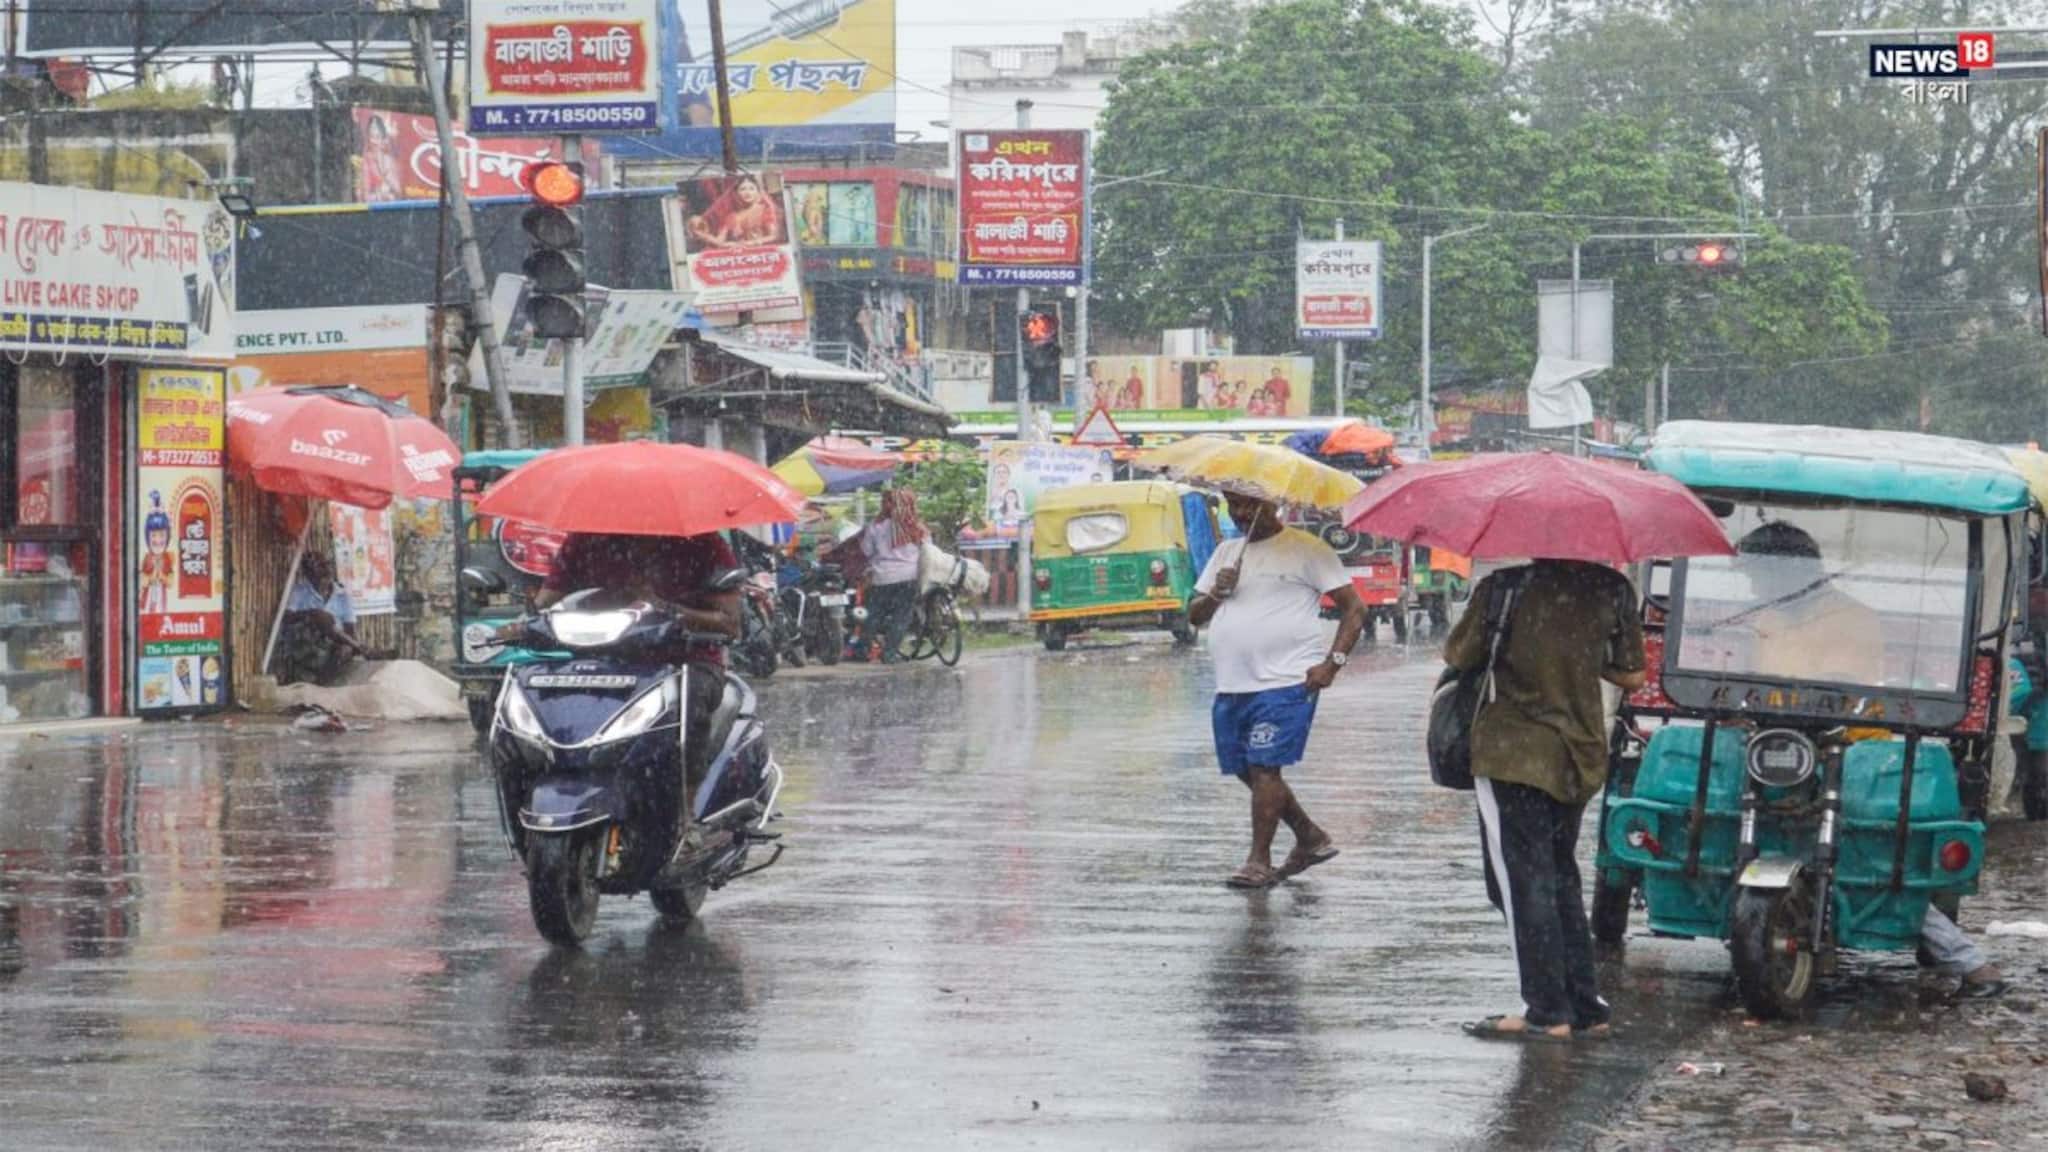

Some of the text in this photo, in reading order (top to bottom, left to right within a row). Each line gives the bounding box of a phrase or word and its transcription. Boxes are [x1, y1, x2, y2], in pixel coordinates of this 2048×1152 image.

[495, 25, 633, 66] বালাজী শাড়ি
[769, 60, 867, 93] পছন্দ
[486, 111, 510, 125] M.
[527, 107, 646, 124] 7718500550
[995, 141, 1053, 155] এখন
[1032, 218, 1067, 244] শাড়ি
[16, 217, 66, 273] কেক
[5, 280, 139, 311] LIVE CAKE SHOP
[237, 331, 348, 348] ENCE PVT. LTD.
[290, 437, 373, 466] baazar
[160, 615, 206, 637] Amul
[147, 645, 162, 656] The
[165, 643, 188, 655] Taste
